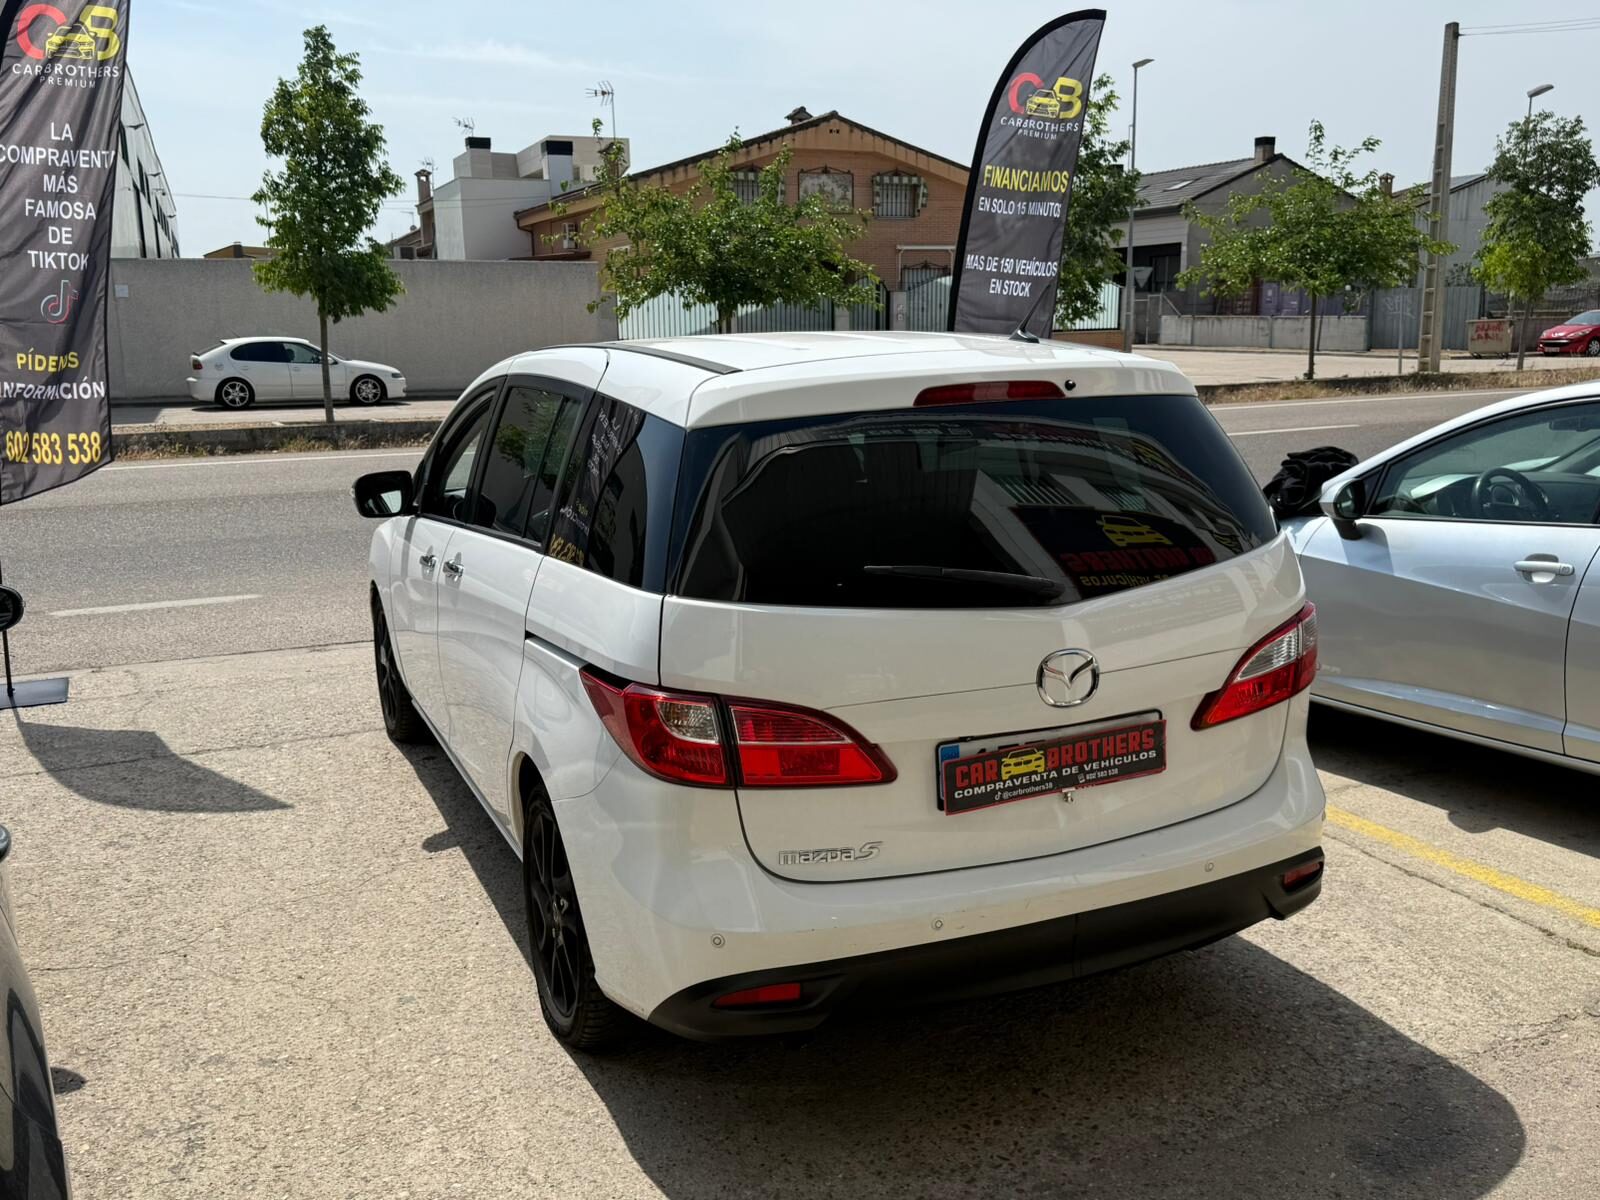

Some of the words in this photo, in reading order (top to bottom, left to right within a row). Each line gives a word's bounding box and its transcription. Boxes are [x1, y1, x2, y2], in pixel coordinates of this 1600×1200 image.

[12, 63, 119, 77] CARBROTHERS
[40, 76, 96, 88] PREMIUM
[51, 122, 73, 142] LA
[1000, 116, 1079, 132] CARBROTHERS
[1017, 129, 1057, 140] PREMIUM
[43, 171, 79, 193] MÁS
[983, 165, 1069, 193] FINANCIAMOS
[25, 199, 96, 220] FAMOSA
[978, 197, 991, 212] EN
[991, 199, 1015, 215] SOLO
[1017, 202, 1026, 214] 15
[48, 226, 73, 245] DE
[28, 250, 89, 271] TIKTOK
[965, 254, 985, 270] MAS
[986, 256, 999, 272] DE
[1000, 258, 1014, 273] 150
[1015, 257, 1058, 277] VEHÍCULOS
[989, 279, 1001, 294] EN
[1002, 280, 1032, 297] STOCK
[0, 376, 105, 400] NFORMACIÓN
[6, 430, 30, 463] 602
[32, 432, 63, 465] 583
[67, 431, 101, 465] 538
[956, 760, 998, 788] CAR
[1047, 729, 1155, 769] BROTHERS
[954, 771, 1058, 799] COMPRAVENTA
[1062, 766, 1079, 776] DE
[1083, 750, 1157, 771] VEHÍCULOS
